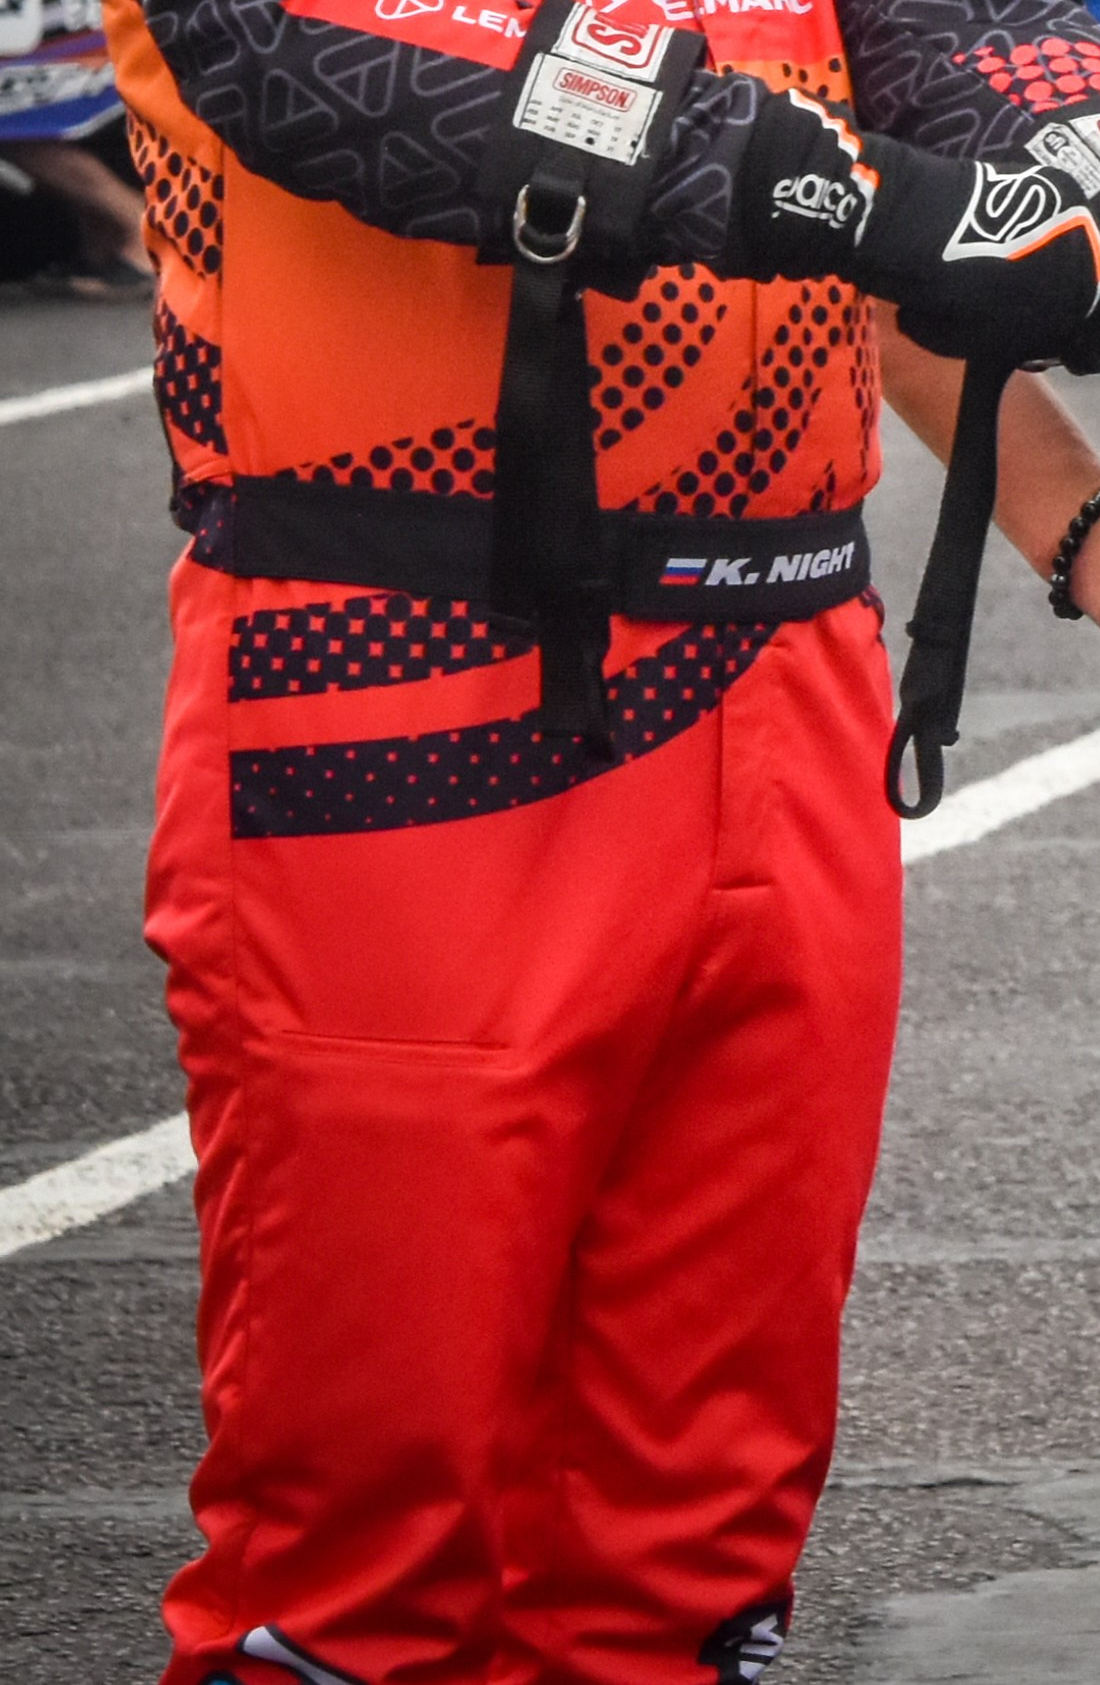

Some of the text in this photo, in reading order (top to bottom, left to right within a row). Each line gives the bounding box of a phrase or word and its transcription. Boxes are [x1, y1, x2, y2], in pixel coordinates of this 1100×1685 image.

[452, 5, 528, 38] LEM
[559, 71, 631, 110] SIMPSON
[704, 541, 855, 586] K. NIGHT
